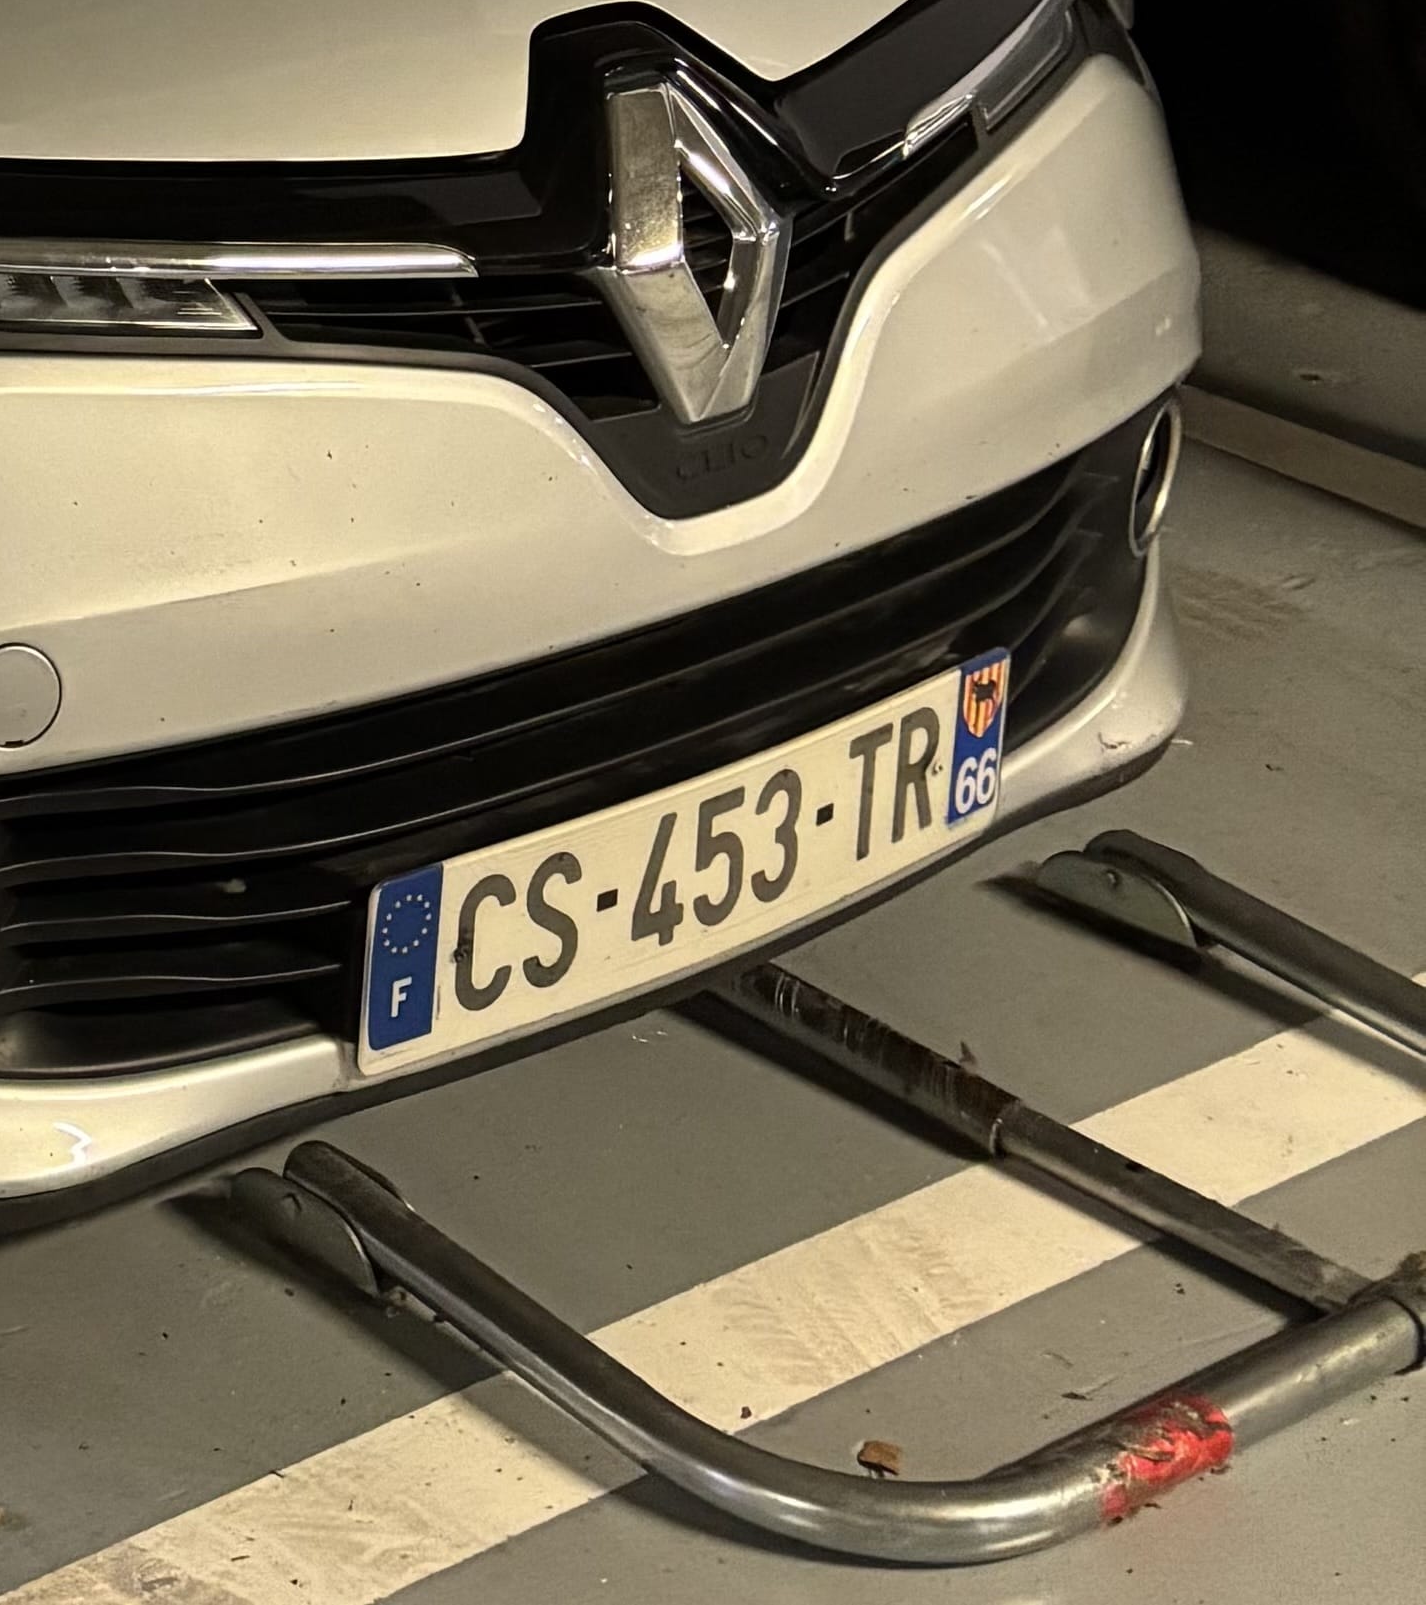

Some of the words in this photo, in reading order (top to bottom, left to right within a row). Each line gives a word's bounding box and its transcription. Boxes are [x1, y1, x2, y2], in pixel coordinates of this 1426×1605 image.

[953, 747, 998, 815] 66
[454, 706, 940, 1013] CS-453-TR
[390, 976, 413, 1019] F
